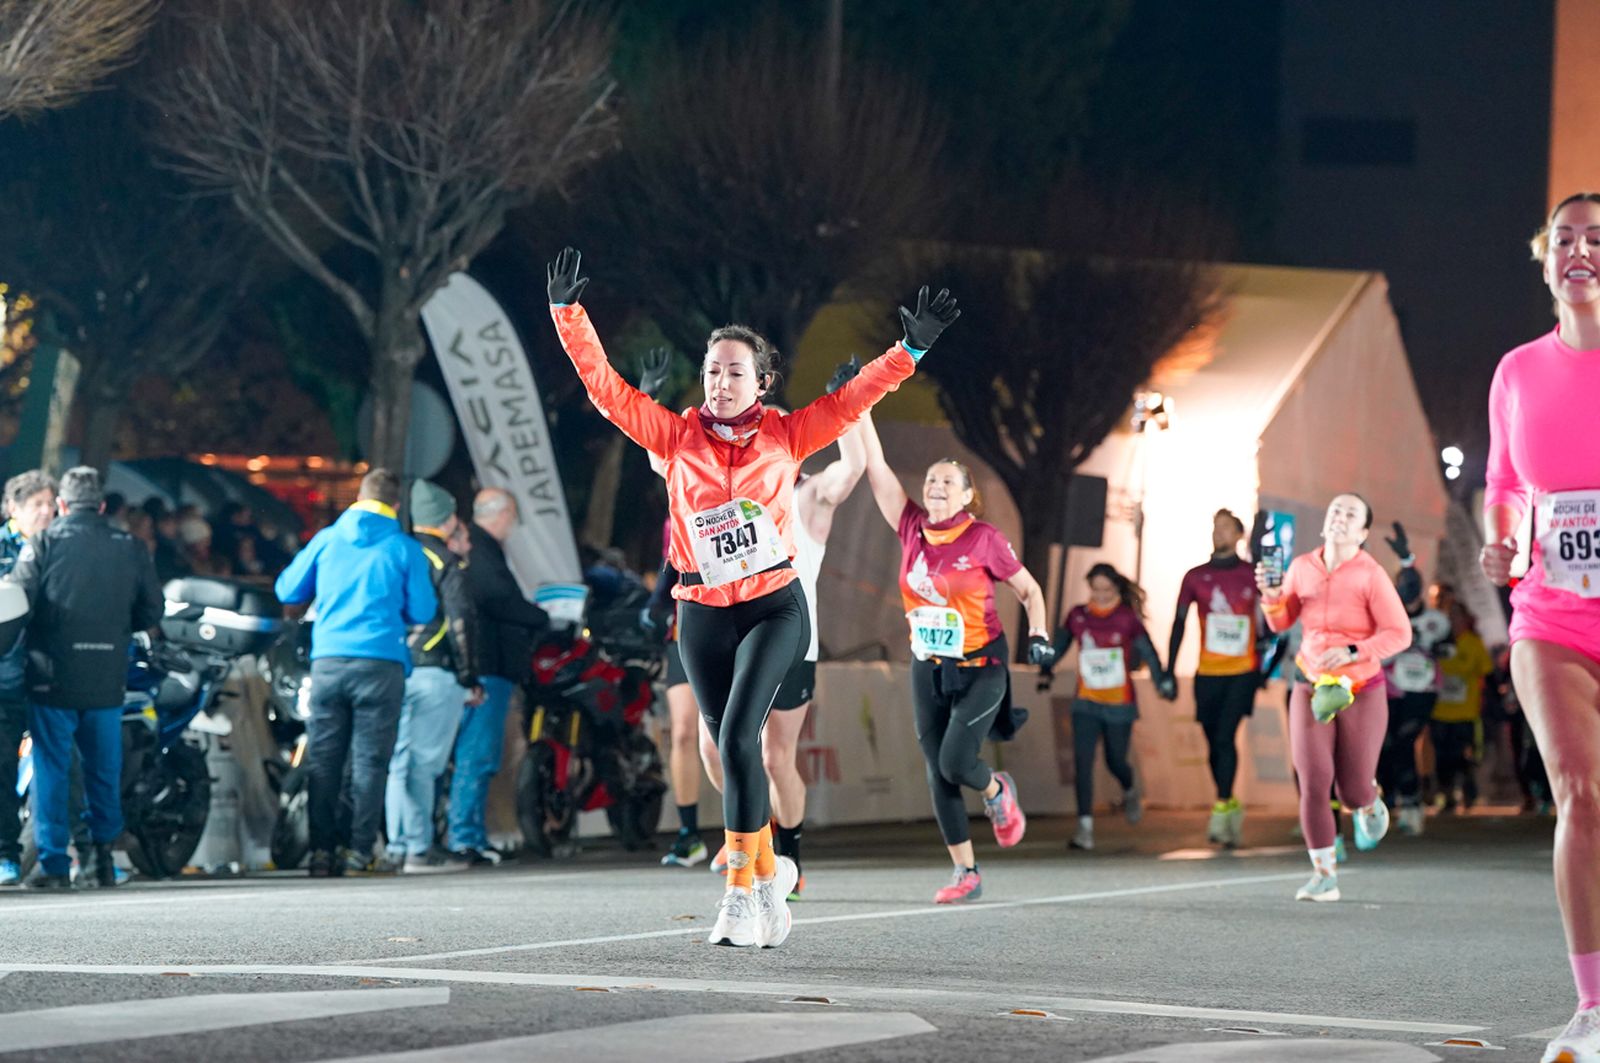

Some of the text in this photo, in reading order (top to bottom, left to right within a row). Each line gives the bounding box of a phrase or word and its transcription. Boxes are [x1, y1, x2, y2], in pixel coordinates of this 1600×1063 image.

[478, 320, 562, 518] JAPEMASA
[1584, 502, 1596, 513] DE
[705, 513, 727, 526] NOCHE
[727, 508, 737, 519] DE
[698, 527, 716, 539] SAN
[710, 522, 758, 558] 7347
[918, 627, 954, 646] 12472
